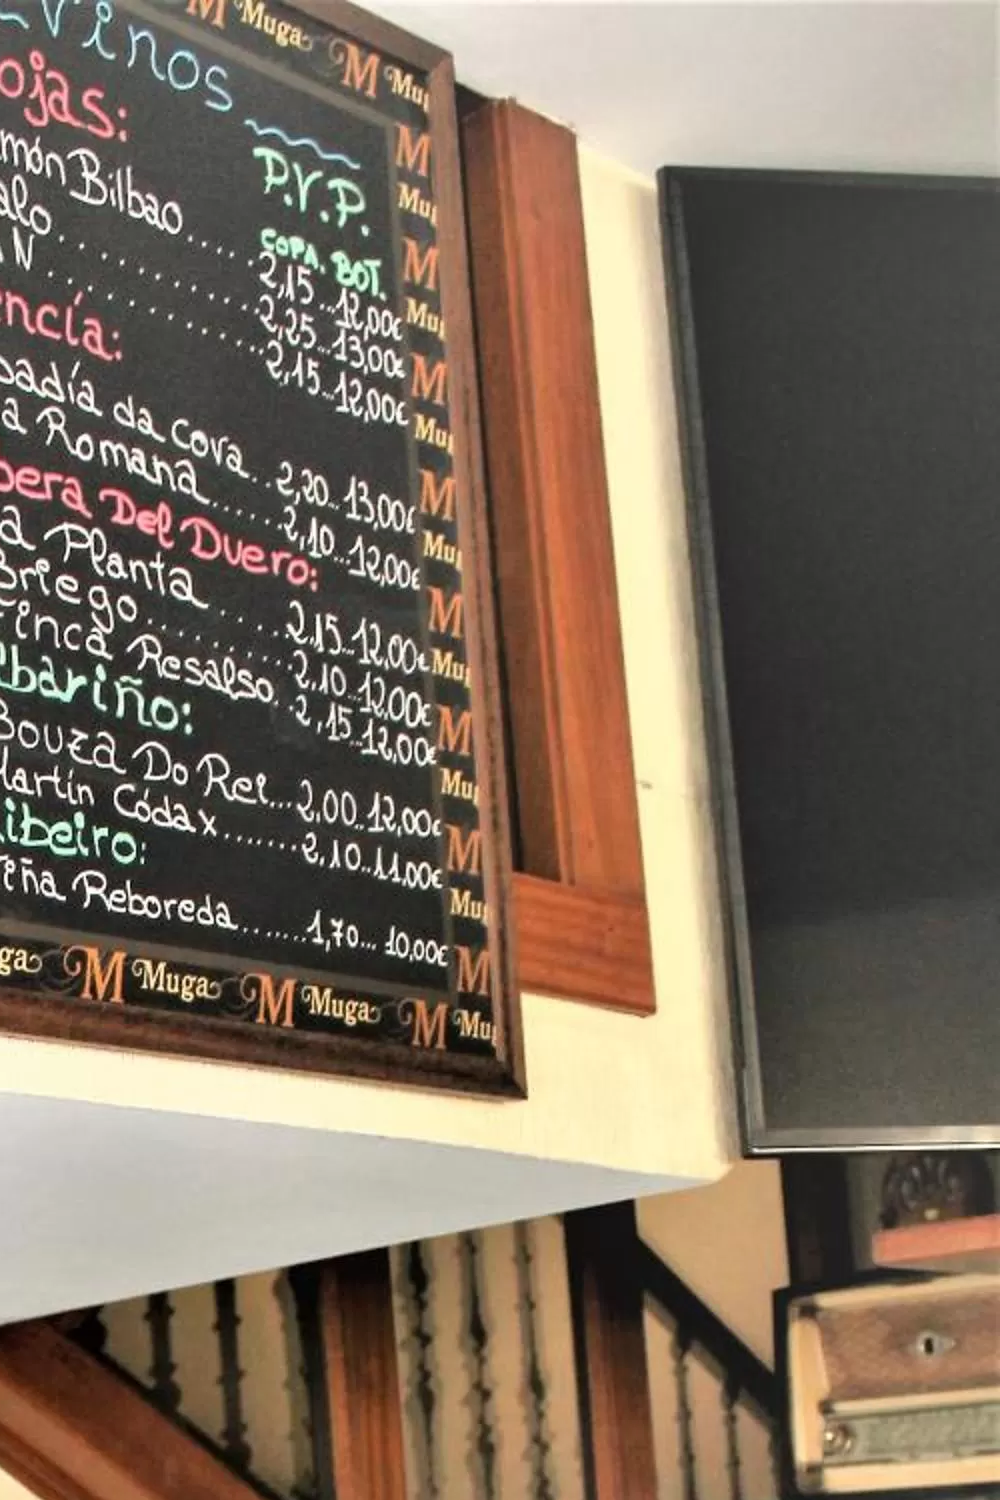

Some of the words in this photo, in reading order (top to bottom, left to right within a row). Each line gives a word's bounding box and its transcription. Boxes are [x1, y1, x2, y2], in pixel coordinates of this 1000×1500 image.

[234, 0, 313, 51] Muga
[330, 38, 381, 97] M
[396, 124, 432, 177] M
[66, 148, 183, 235] Bilbao
[253, 147, 370, 237] P.V.P.
[403, 237, 440, 291] M
[410, 353, 447, 405] M
[113, 396, 166, 443] da
[36, 407, 210, 505] Romana
[419, 468, 456, 521] M
[43, 521, 209, 609] Planta
[99, 487, 174, 549] Del
[179, 516, 318, 592] Duero:
[427, 587, 463, 638] M
[126, 634, 274, 703] Resalso
[436, 704, 471, 755] M
[132, 740, 188, 785] Do
[444, 824, 481, 875] M
[72, 870, 238, 930] Reboreda
[64, 945, 129, 1004] M
[131, 959, 221, 1002] Muga
[240, 973, 297, 1028] M
[301, 984, 381, 1026] Muga
[398, 998, 449, 1050] M
[454, 946, 490, 995] M
